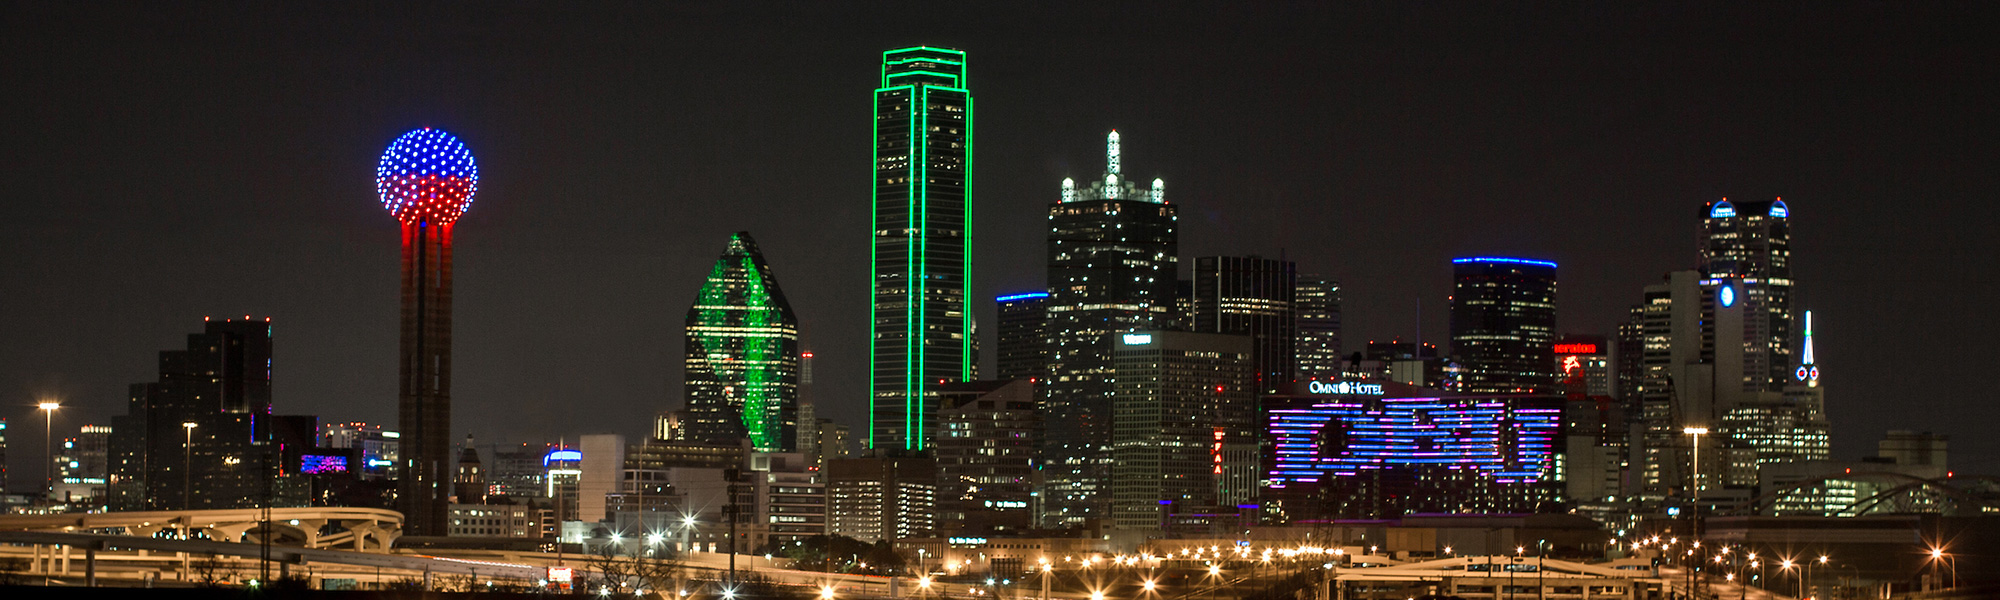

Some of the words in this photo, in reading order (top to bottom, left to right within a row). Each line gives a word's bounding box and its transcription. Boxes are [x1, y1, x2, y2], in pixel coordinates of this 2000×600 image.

[1309, 380, 1339, 394] OMNI
[1349, 381, 1385, 395] HOTEL
[1213, 431, 1223, 475] WFAA
